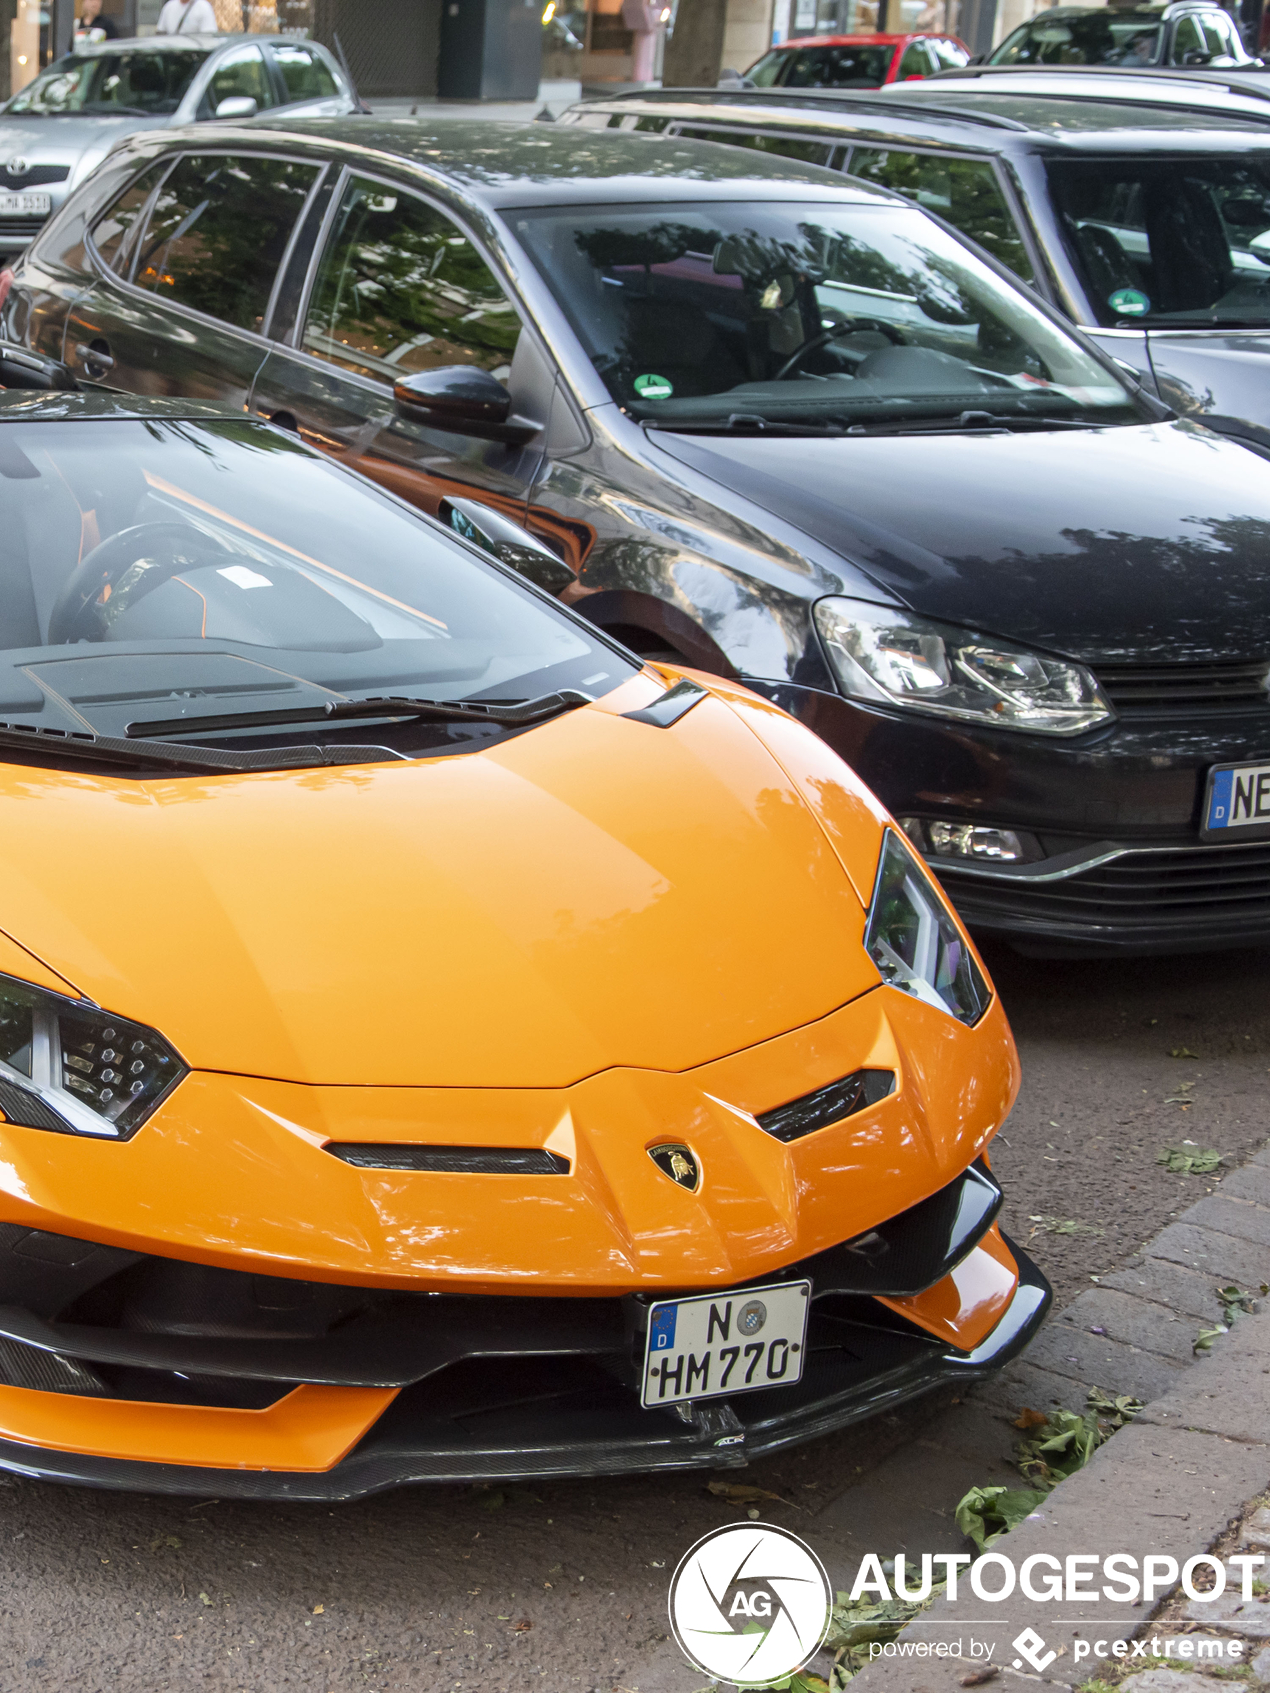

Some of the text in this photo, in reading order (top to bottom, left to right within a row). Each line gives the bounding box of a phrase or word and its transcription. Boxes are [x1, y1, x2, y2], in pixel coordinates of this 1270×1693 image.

[647, 375, 658, 386] 4
[1232, 773, 1270, 820] NE
[1215, 806, 1225, 819] D
[707, 1301, 732, 1344] N
[657, 1334, 667, 1347] D
